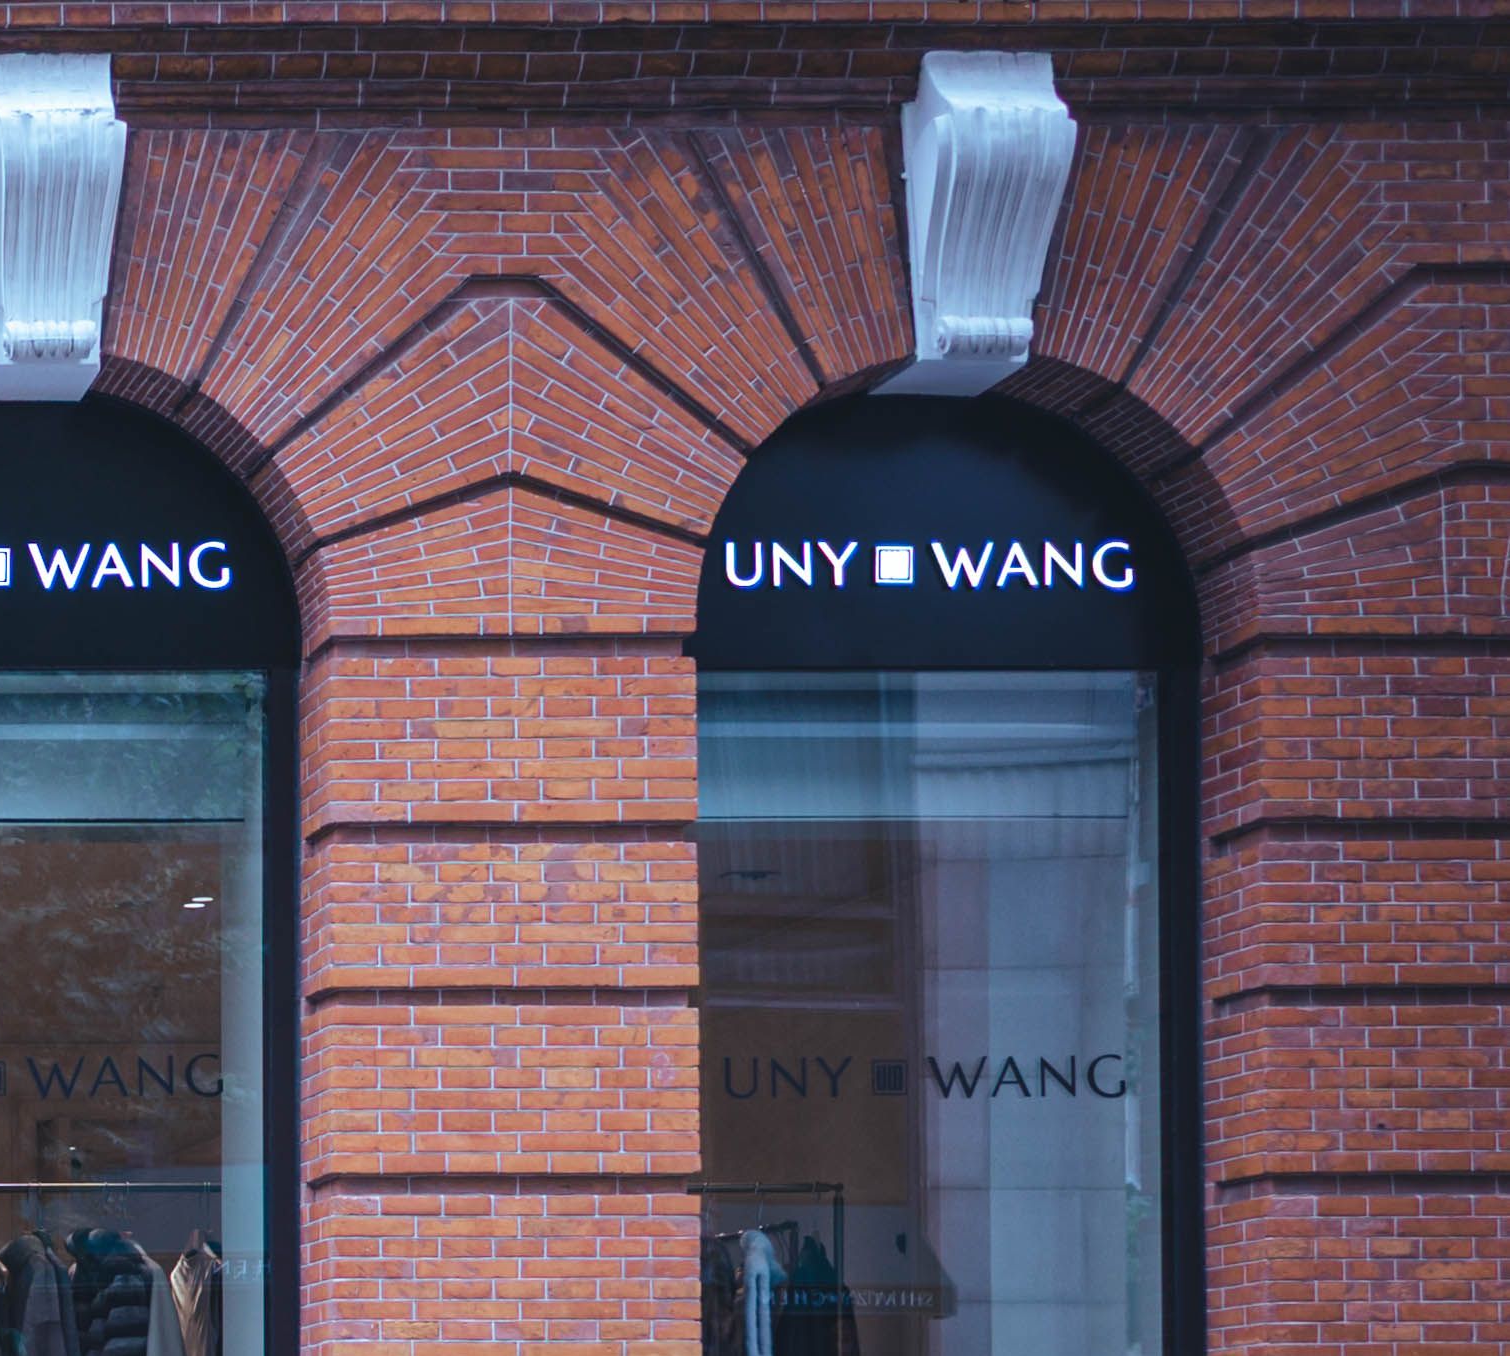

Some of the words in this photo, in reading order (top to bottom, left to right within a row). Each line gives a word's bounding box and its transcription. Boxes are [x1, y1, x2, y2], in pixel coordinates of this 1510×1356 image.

[29, 542, 232, 590] WANG
[726, 539, 858, 588] UNY
[932, 539, 1133, 590] WANG
[25, 1053, 224, 1100] WANG
[723, 1056, 852, 1099] UNY
[927, 1054, 1127, 1099] WANG
